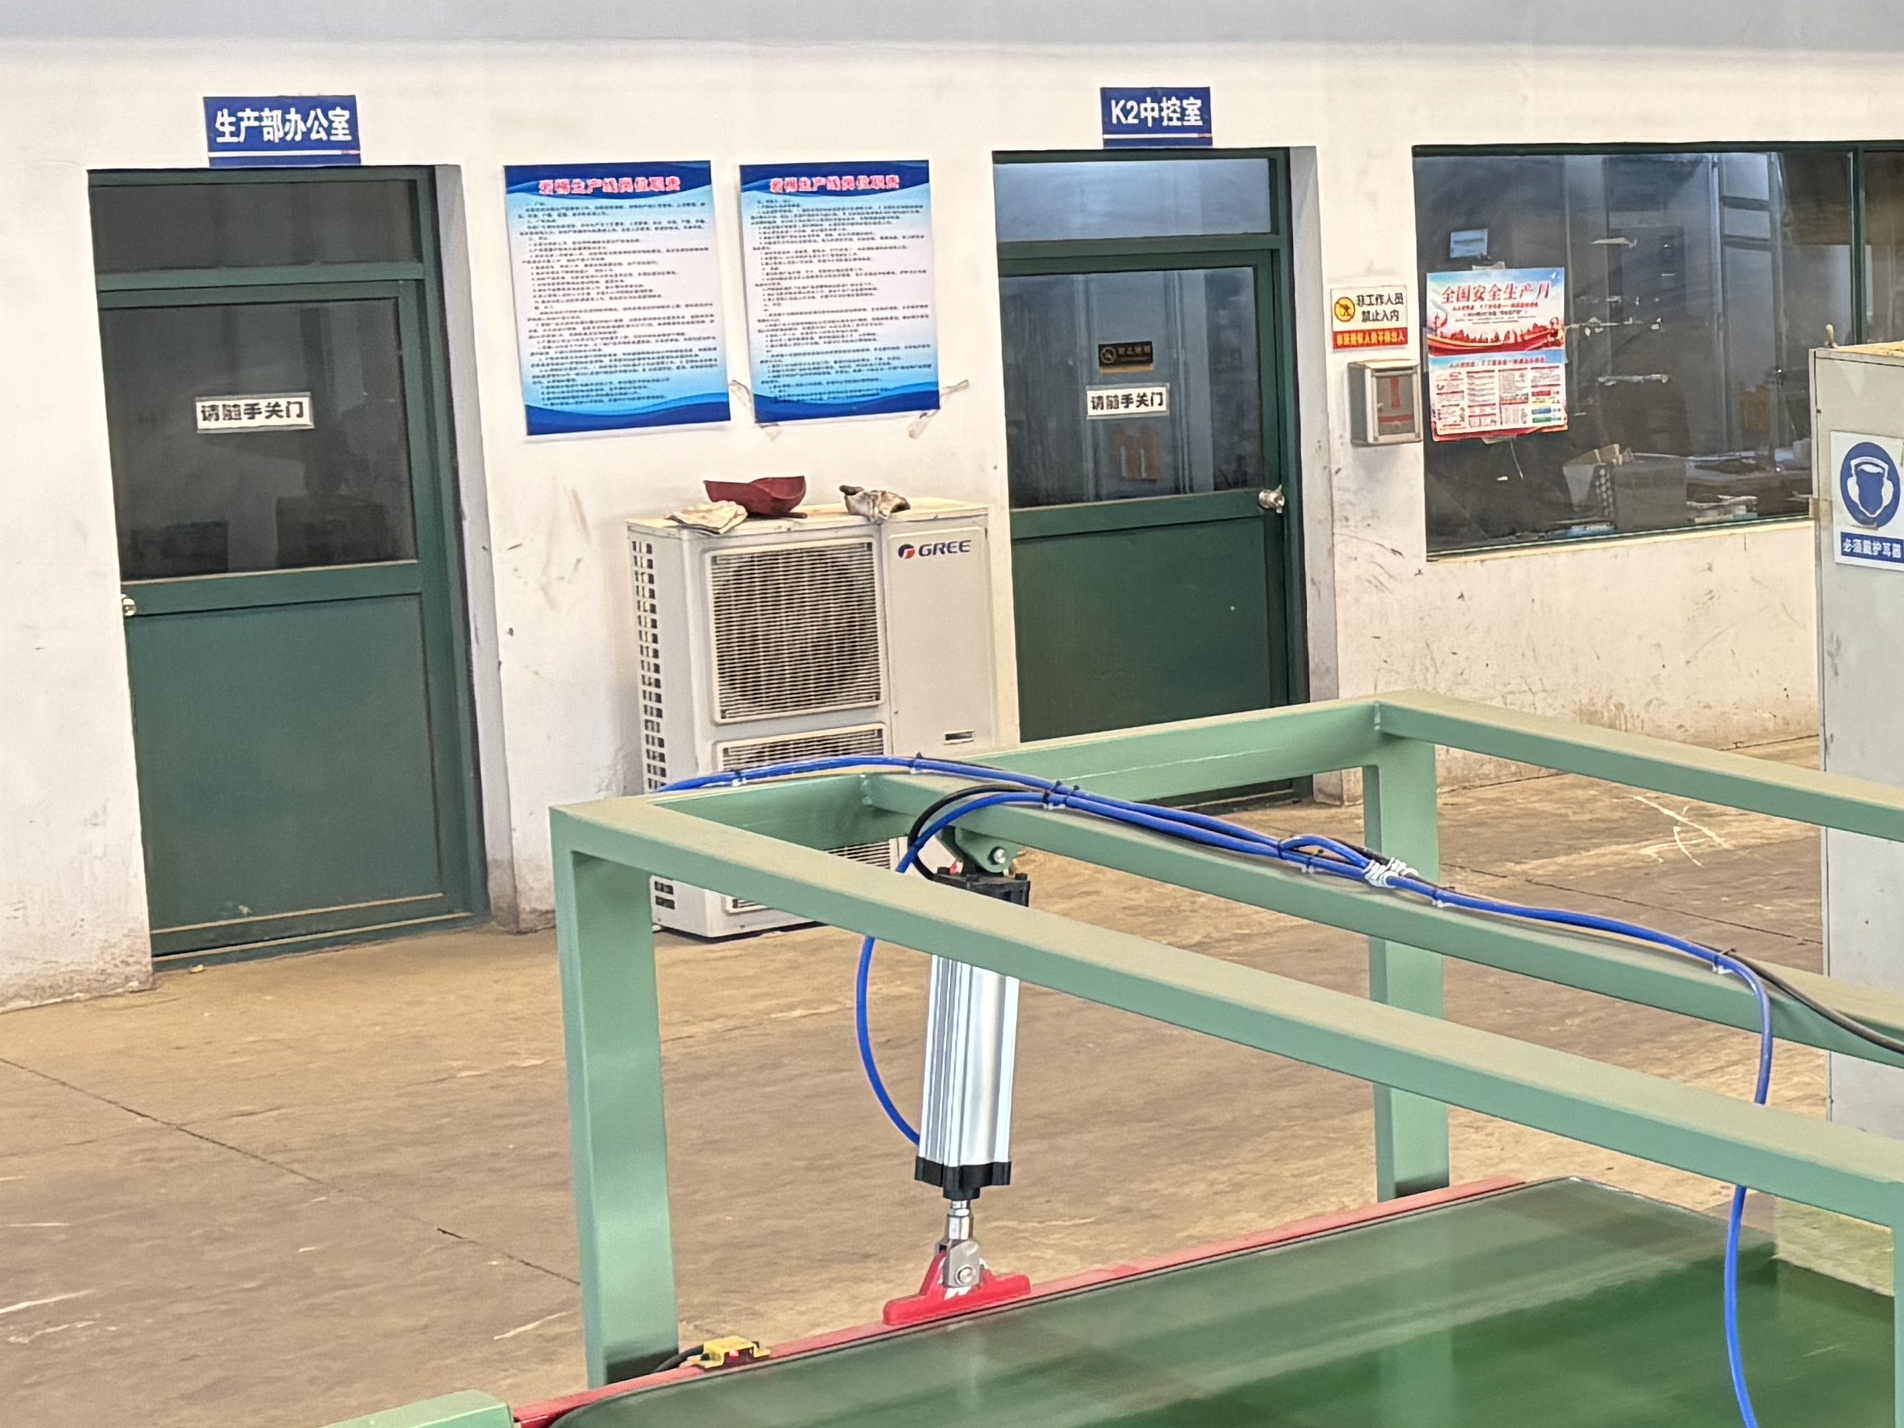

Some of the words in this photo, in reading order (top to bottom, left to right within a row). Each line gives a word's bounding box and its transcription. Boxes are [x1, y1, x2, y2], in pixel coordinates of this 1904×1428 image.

[1110, 96, 1204, 128] K2中控室
[215, 106, 353, 143] 生产部办公室
[1356, 292, 1404, 307] 非工作人员
[1441, 281, 1551, 304] 全国安全生产月
[201, 400, 305, 422] 请随手关门
[1091, 391, 1164, 411] 请随手关门
[918, 539, 972, 557] GREE
